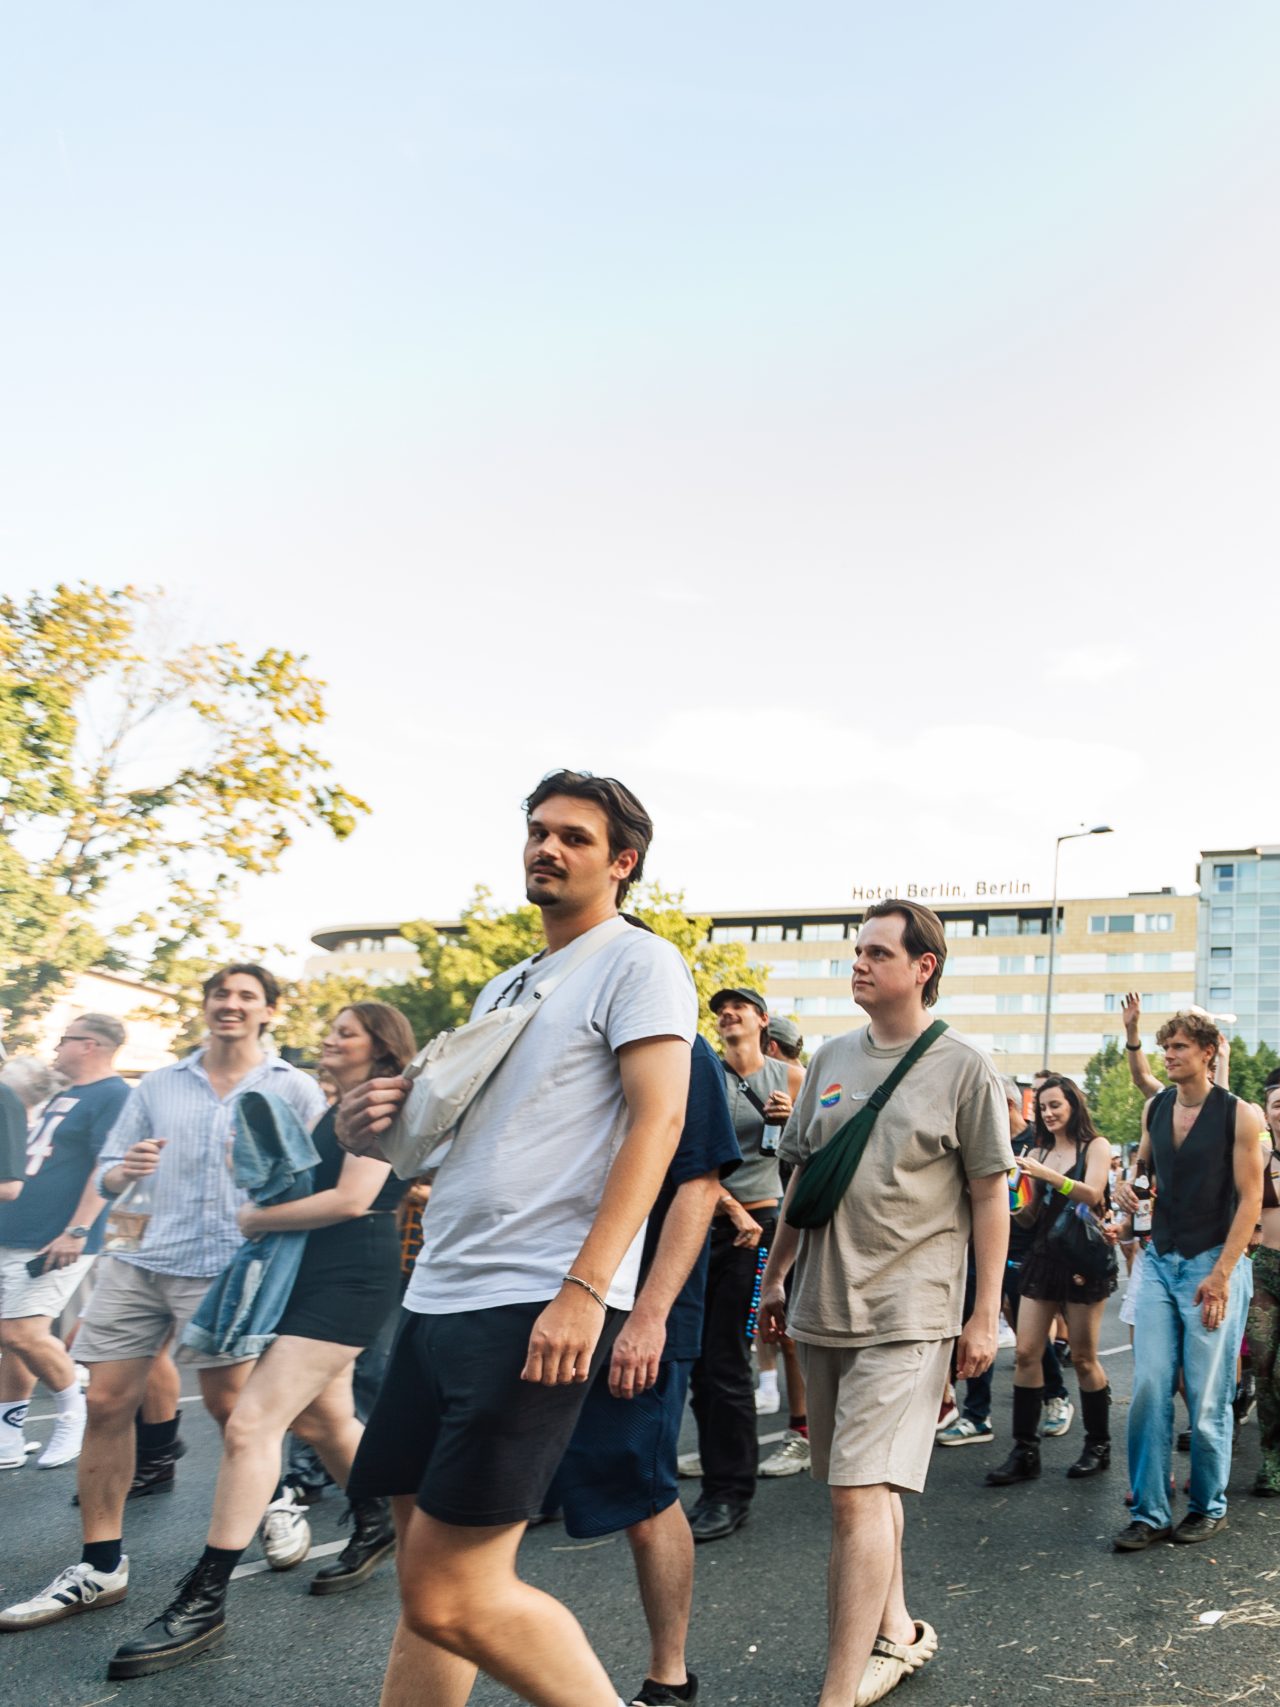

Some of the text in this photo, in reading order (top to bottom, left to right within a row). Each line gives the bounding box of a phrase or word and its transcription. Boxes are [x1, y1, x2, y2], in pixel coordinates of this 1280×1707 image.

[852, 879, 1031, 900] Hotel Berlin, Berlin
